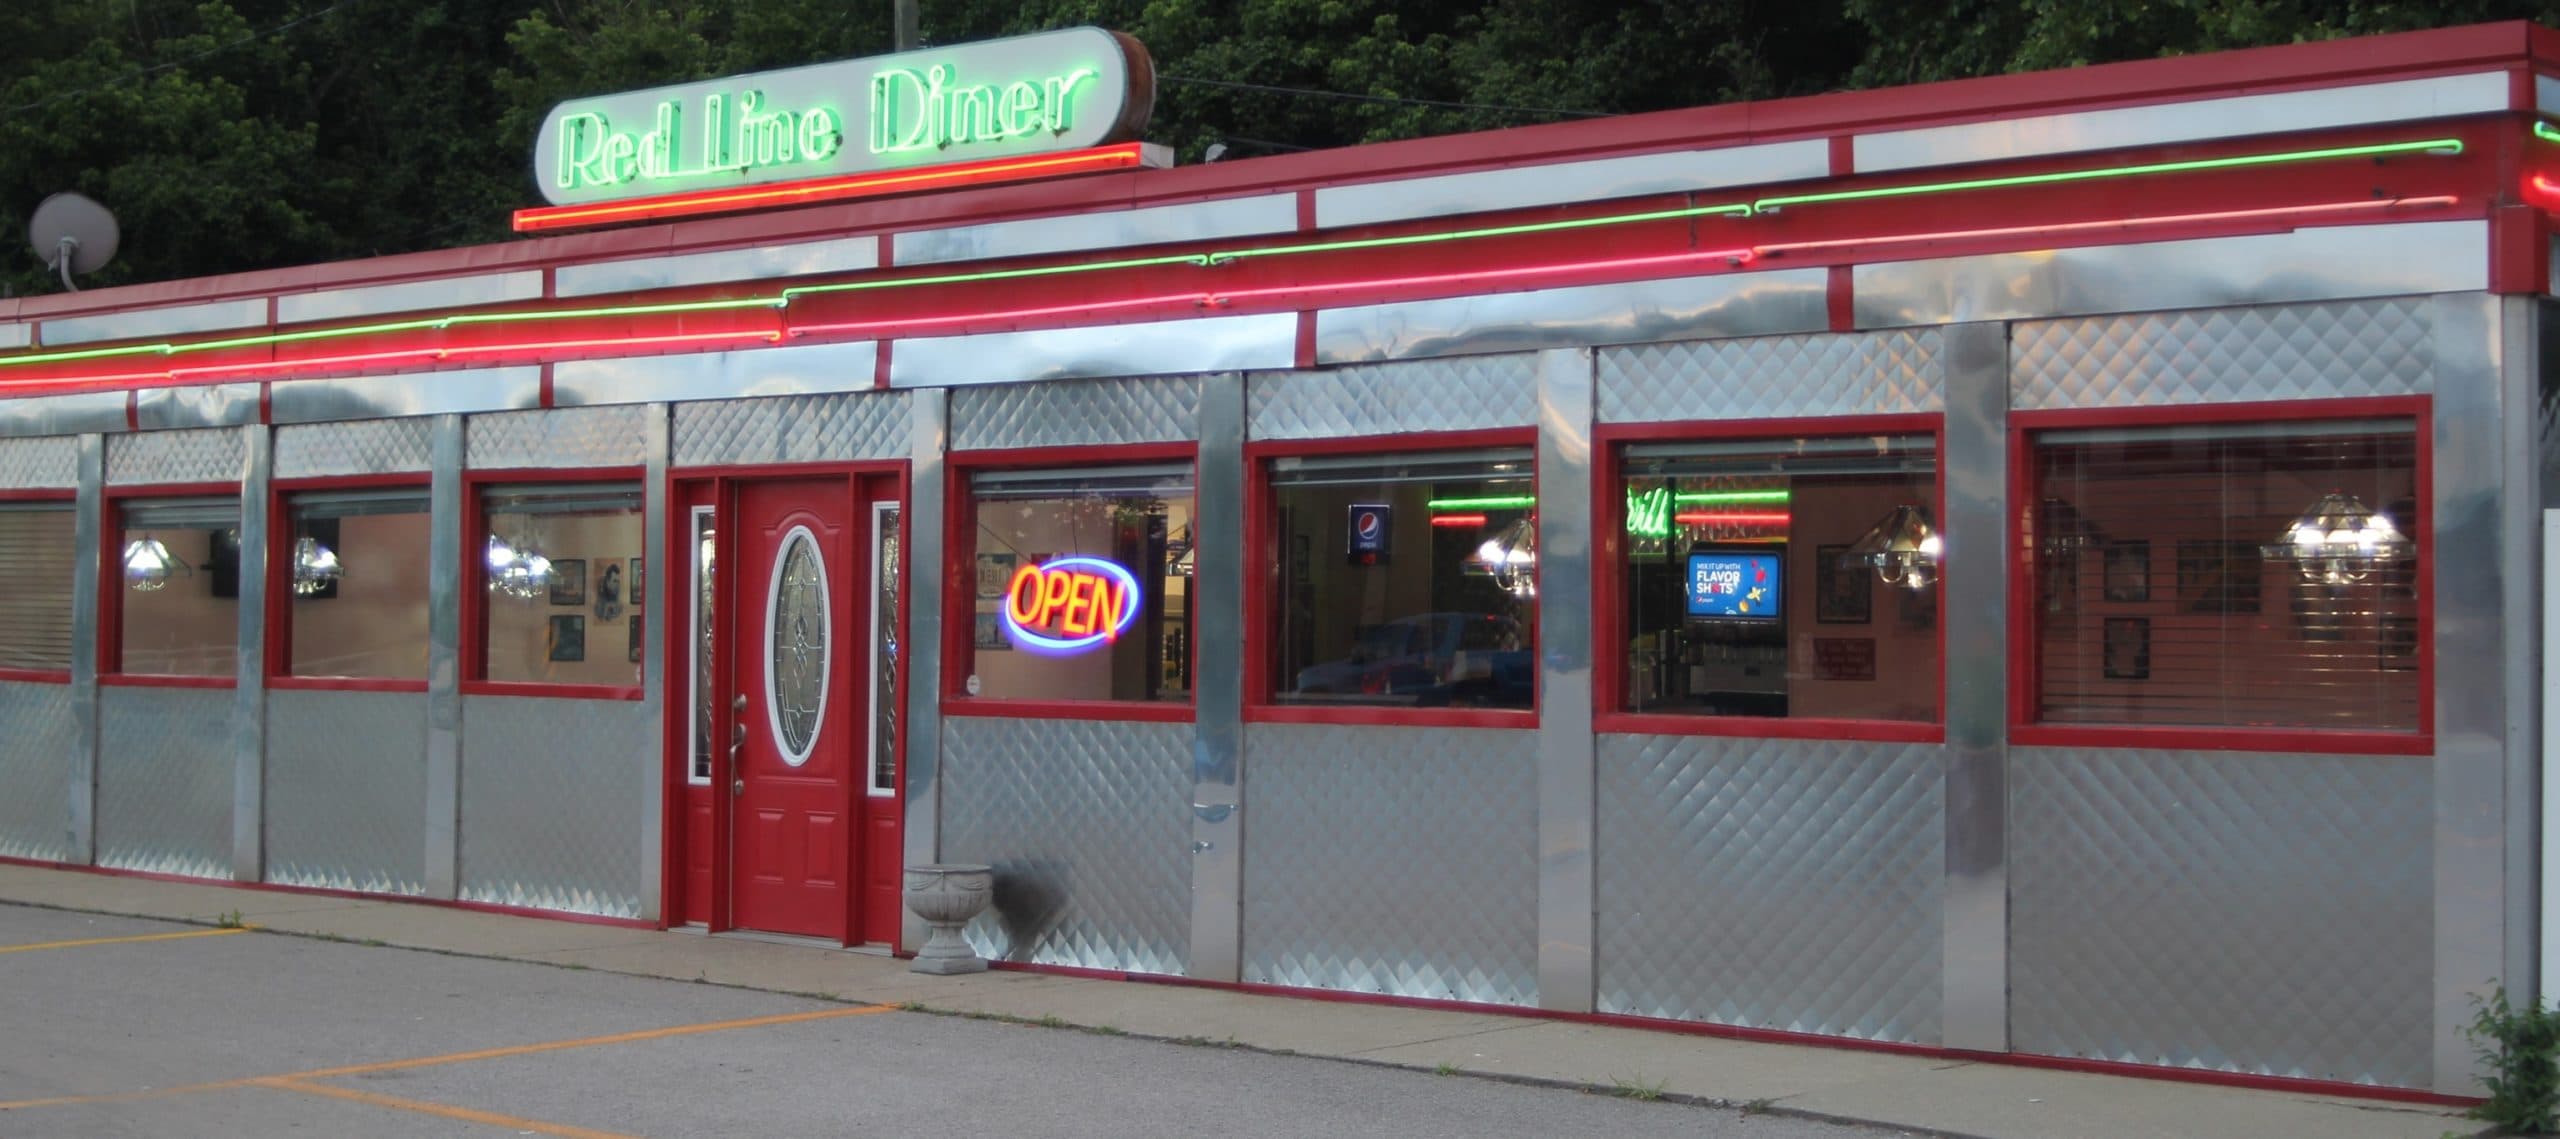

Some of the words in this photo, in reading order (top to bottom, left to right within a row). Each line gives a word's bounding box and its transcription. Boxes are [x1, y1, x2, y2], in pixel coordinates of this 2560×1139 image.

[557, 101, 681, 190] Red
[703, 89, 843, 172] Line
[869, 63, 1100, 155] Diner
[1010, 564, 1126, 639] OPEN
[1696, 570, 1741, 583] FLAVOR
